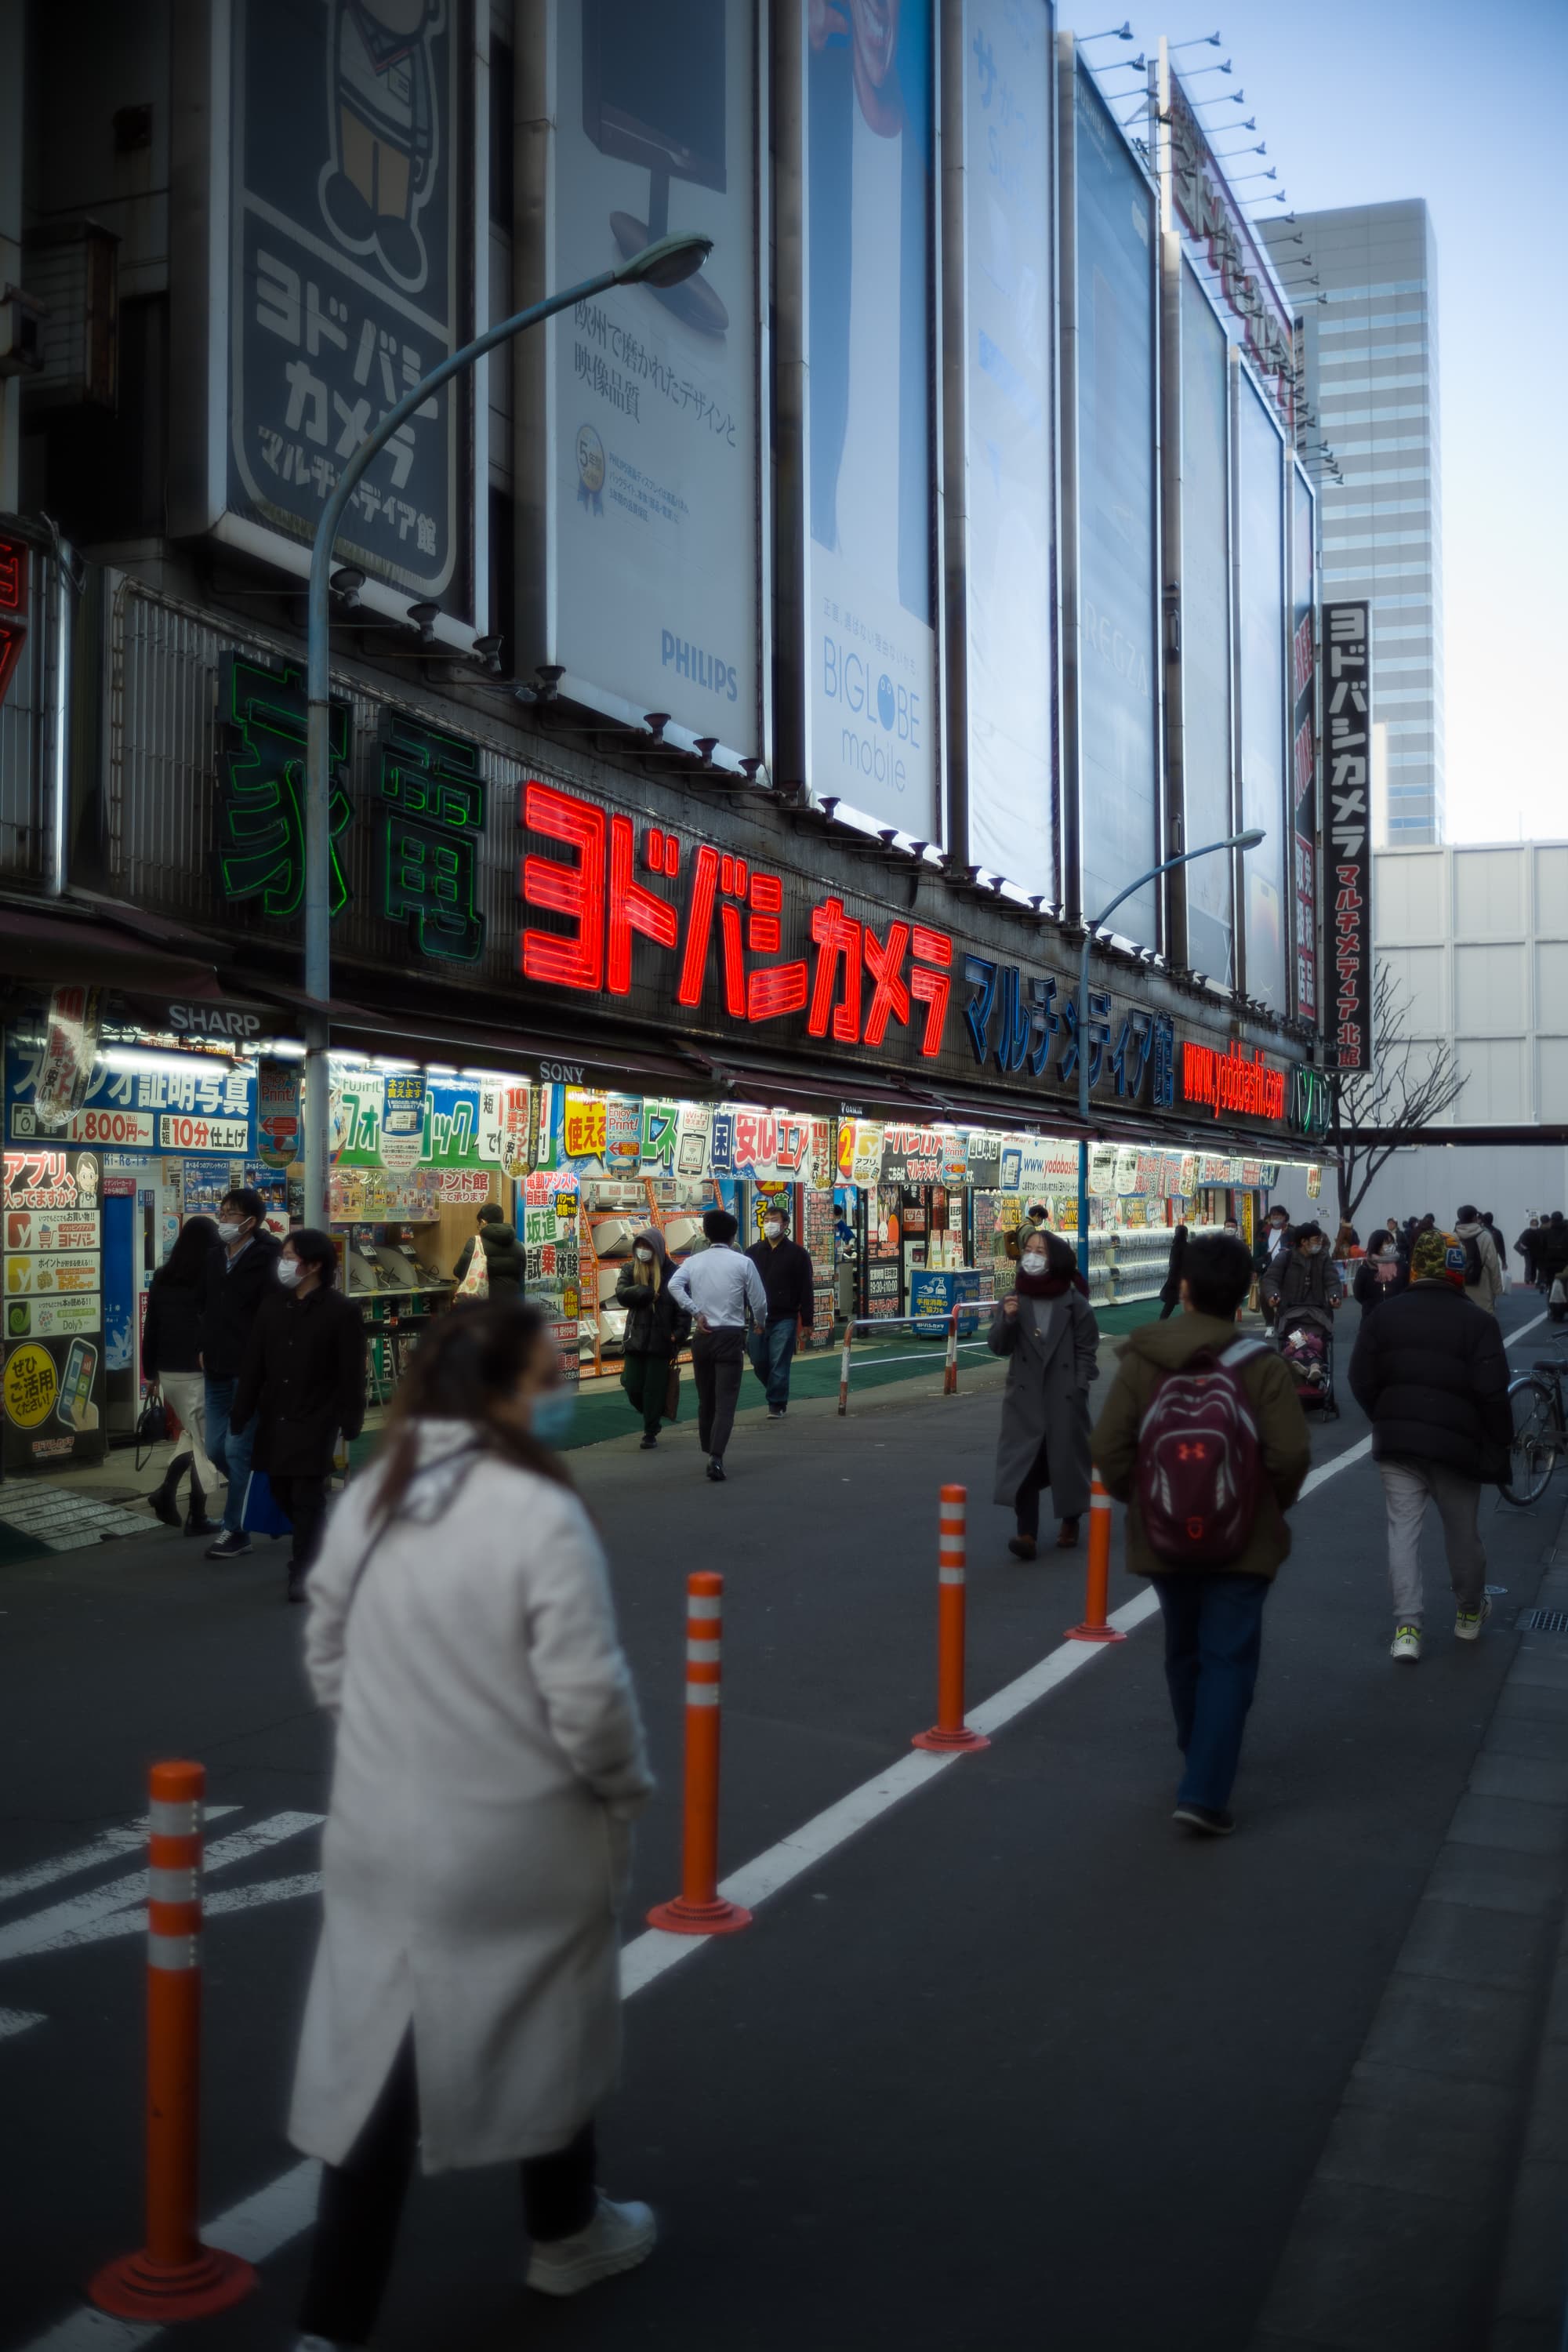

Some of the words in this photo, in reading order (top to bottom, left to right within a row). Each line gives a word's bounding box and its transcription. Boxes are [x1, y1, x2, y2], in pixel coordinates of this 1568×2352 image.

[256, 248, 438, 419] ヨドバシ
[574, 302, 736, 448] 欧州で磨かれたデザインと
[574, 339, 641, 424] 映像品質
[285, 359, 417, 490] カメラ
[1083, 597, 1149, 698] REGZA
[661, 629, 739, 702] PHILIPS
[824, 635, 920, 750] BIGLOBE
[1328, 608, 1367, 858] ヨドバシカメラ
[842, 727, 906, 793] mobile
[213, 649, 488, 964] 家電
[521, 779, 953, 1058] ヨドバシカメラ
[1336, 865, 1362, 1067] マルチメディア北館
[169, 1004, 260, 1036] SHARP
[960, 953, 1174, 1109] マルチメディア館
[261, 1072, 287, 1088] Enjoy
[388, 1079, 421, 1089] ネットで
[540, 1062, 585, 1084] SONY
[1182, 1038, 1284, 1119] www.yodobashi.com
[261, 1085, 296, 1102] Print!
[387, 1088, 423, 1098] 買えます
[506, 1088, 528, 1112] 10
[608, 1118, 639, 1130] Print!
[609, 1107, 631, 1120] Enjoy
[686, 1109, 707, 1120] Wi-Fi
[172, 1119, 209, 1148] 10分
[210, 1127, 246, 1149] 仕上げ
[517, 1112, 528, 1162] ポイント
[820, 1140, 829, 1175] ポイント
[945, 1147, 966, 1156] Print!
[4, 1152, 75, 1188] アプリ、
[526, 1172, 578, 1191] 電動アシスト
[888, 1166, 906, 1181] こちらは
[4, 1189, 77, 1207] 入ってますか?
[526, 1191, 554, 1205] 自転車の
[526, 1208, 557, 1243] 坂道
[1065, 1210, 1078, 1223] JUNG
[58, 1232, 95, 1248] ヨドバシ
[527, 1243, 579, 1280] 試乗体験
[13, 1356, 38, 1378] ぜひ
[10, 1368, 54, 1403] ご活用
[15, 1394, 50, 1417] ください!
